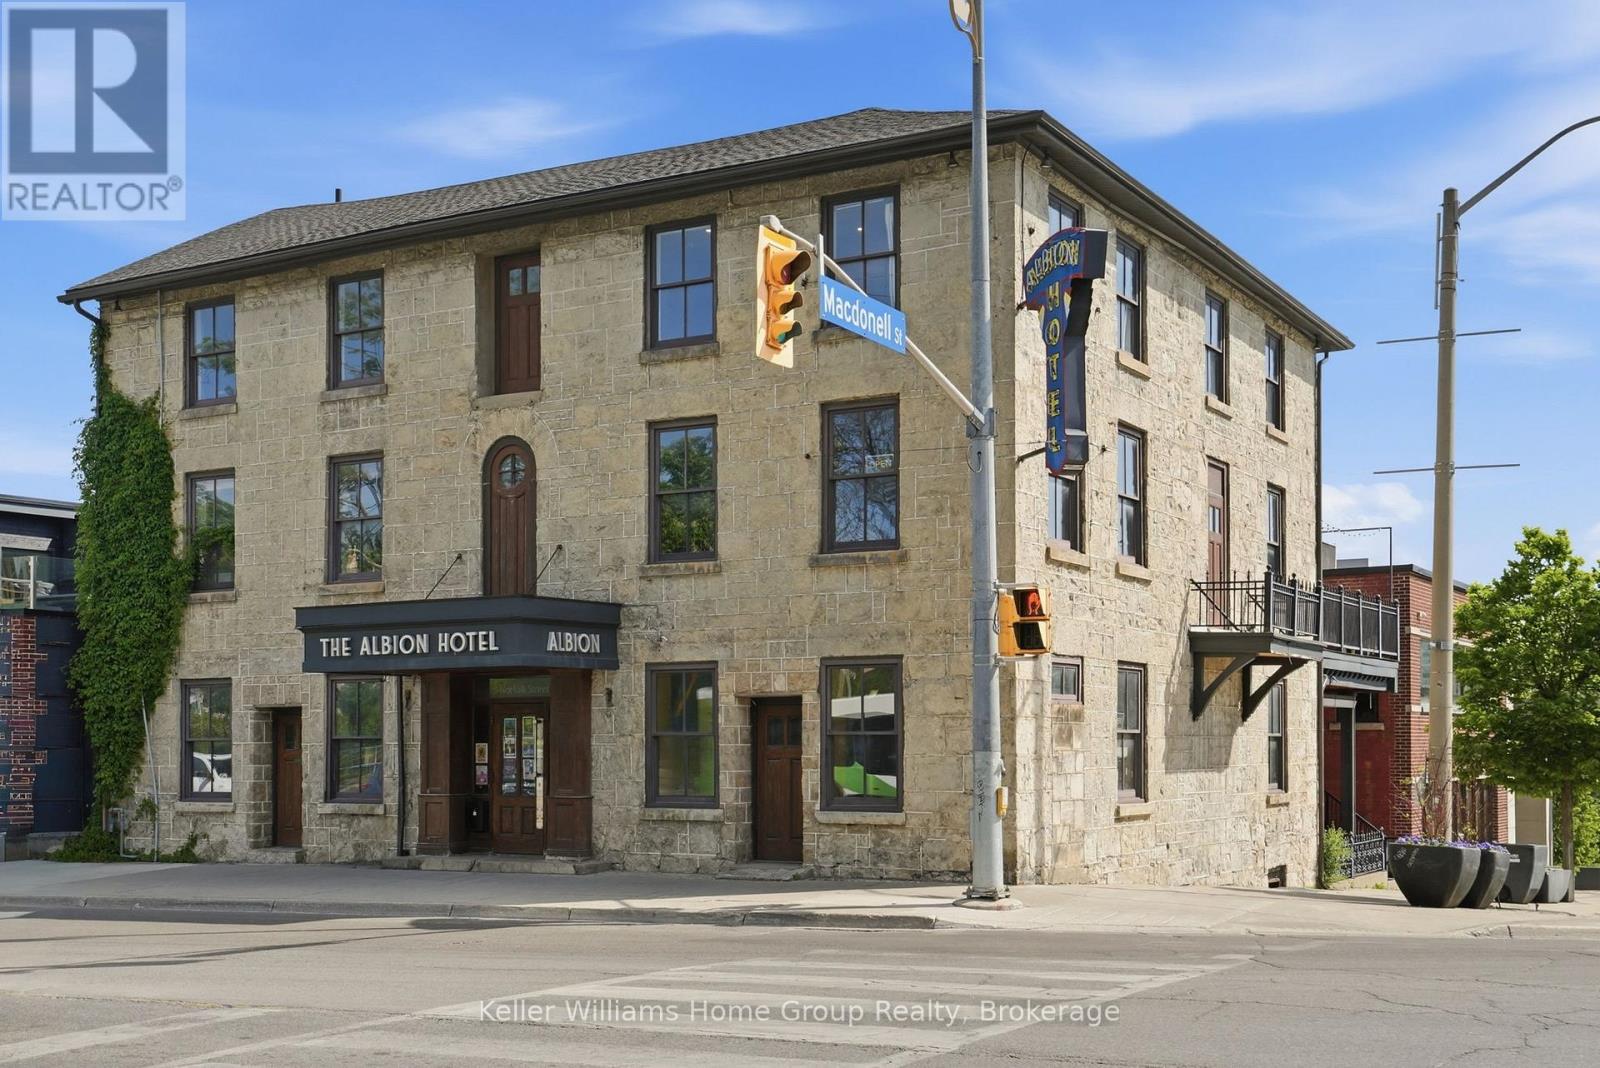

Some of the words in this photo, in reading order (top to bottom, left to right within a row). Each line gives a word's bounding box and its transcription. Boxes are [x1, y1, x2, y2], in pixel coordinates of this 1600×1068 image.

[1026, 239, 1080, 294] ALBION
[823, 284, 892, 340] Macdonell
[1045, 281, 1061, 453] HOTEL
[319, 637, 351, 657] THE
[360, 633, 429, 656] ALBION
[438, 630, 499, 653] HOTEL
[546, 631, 600, 654] ALBION
